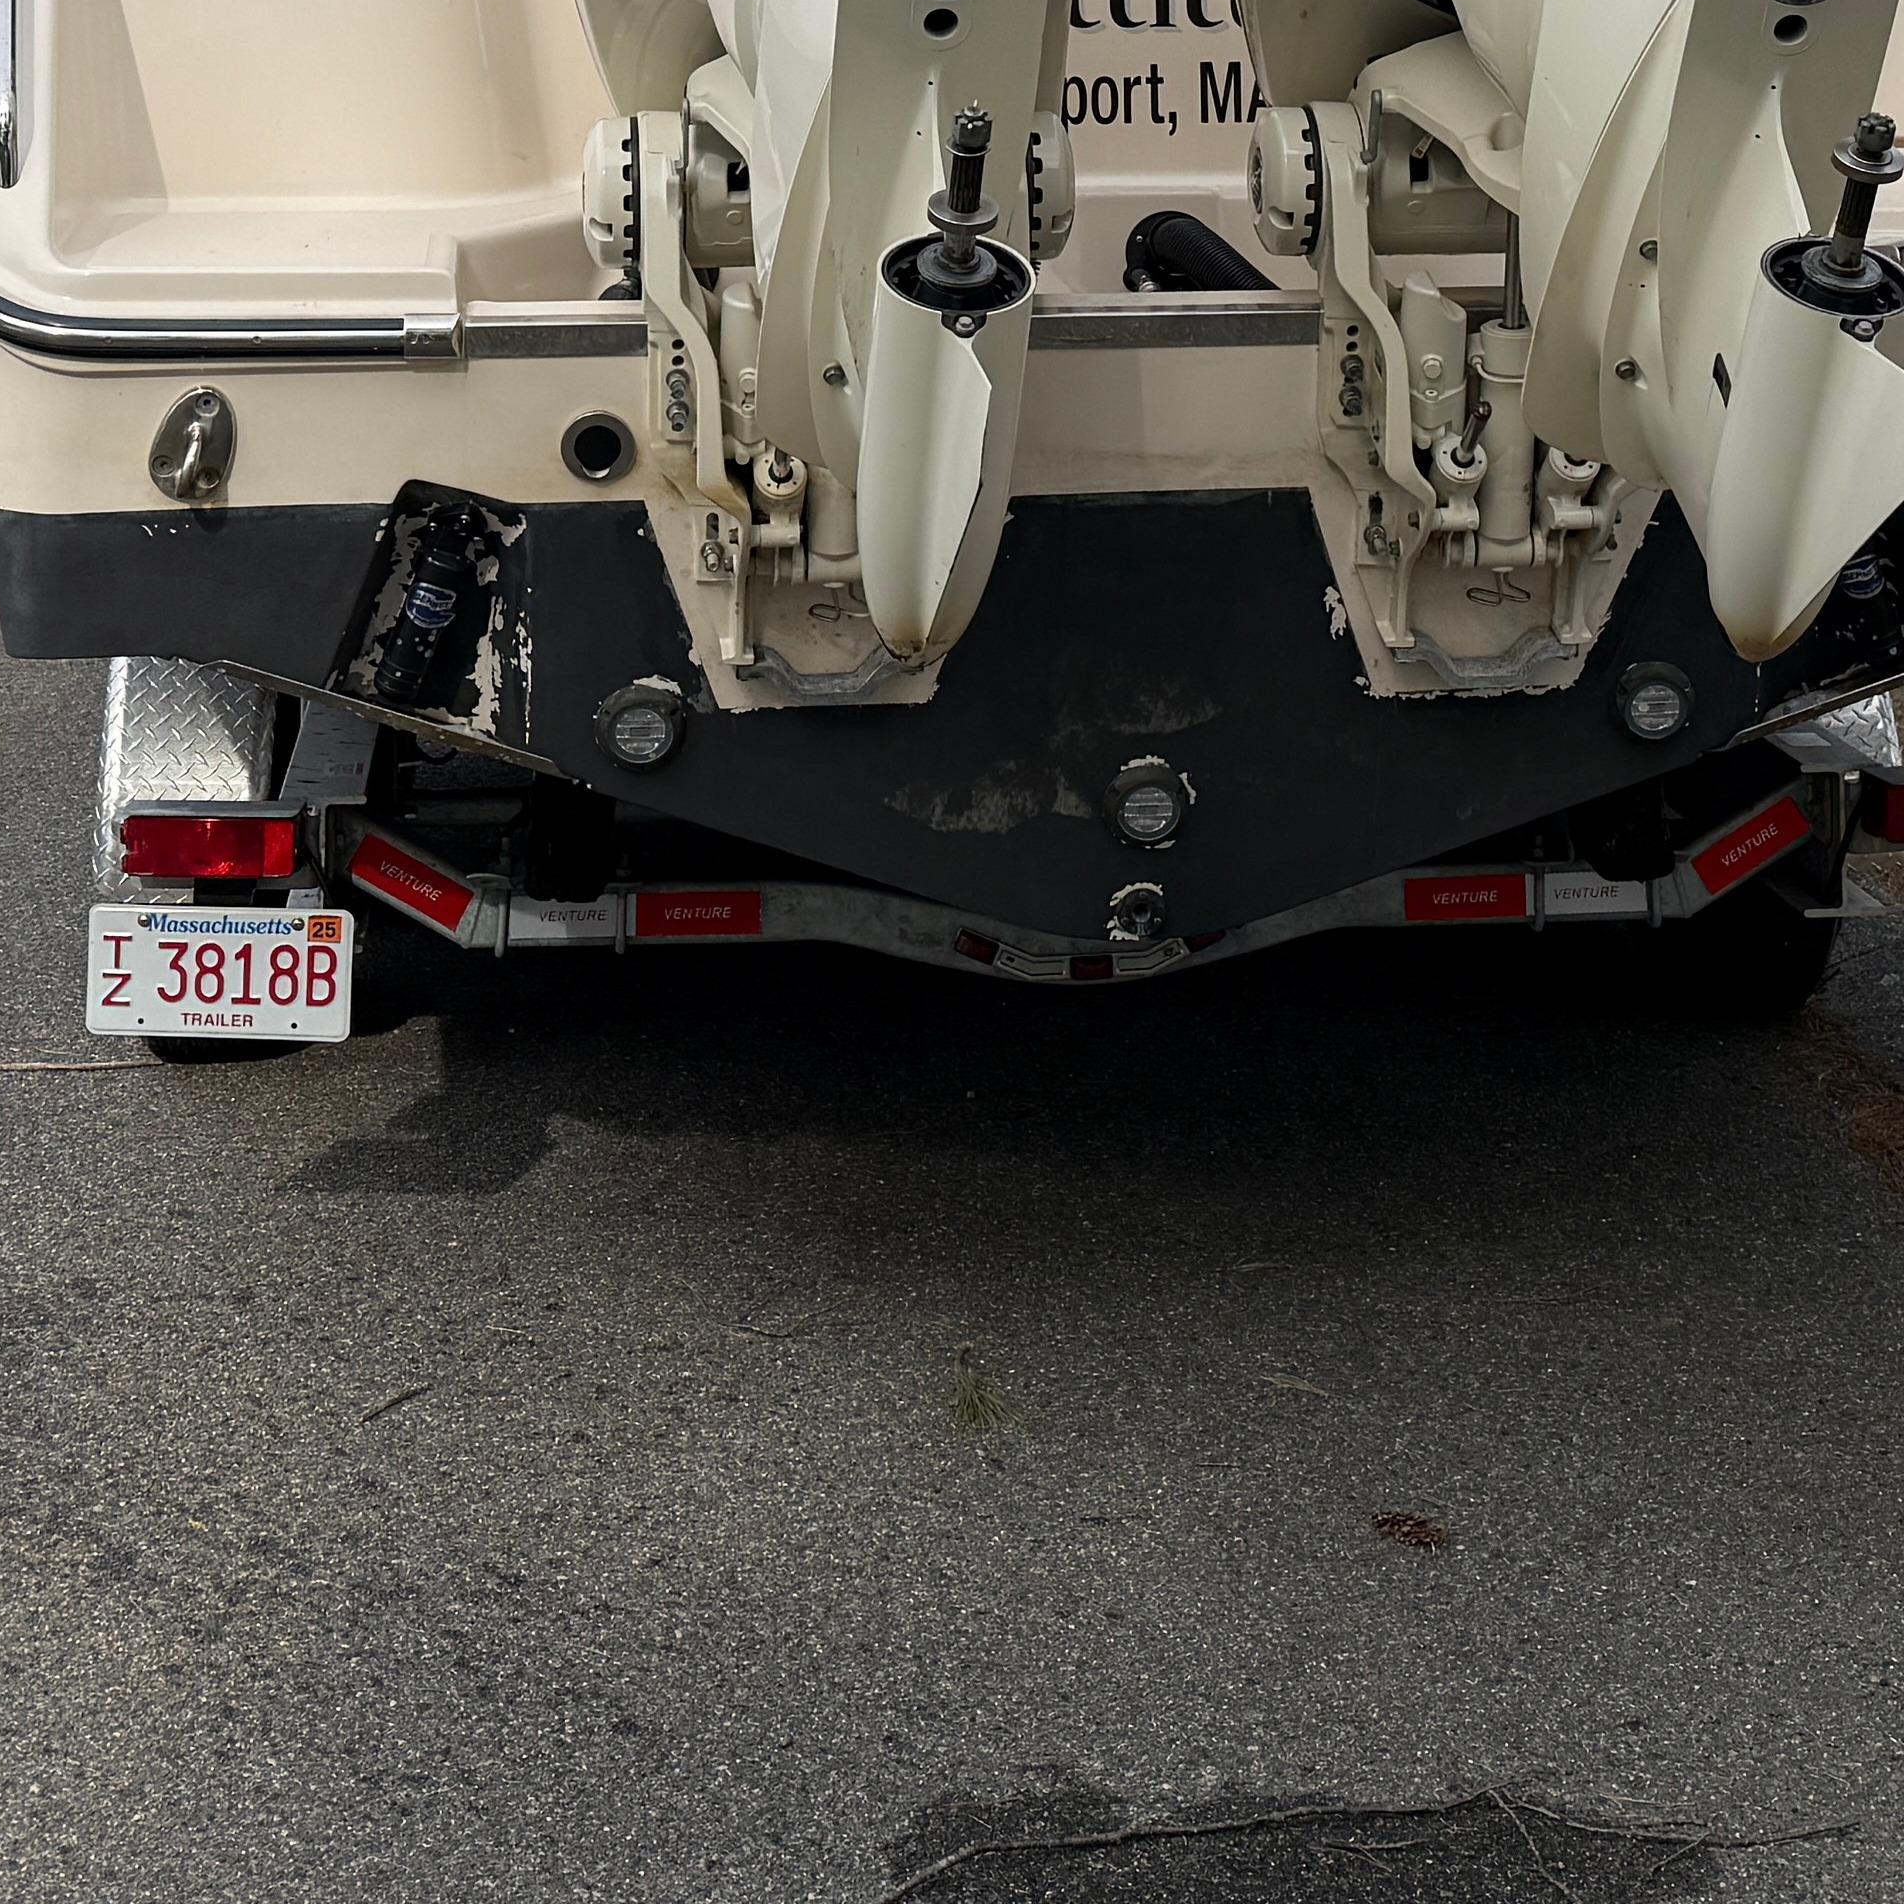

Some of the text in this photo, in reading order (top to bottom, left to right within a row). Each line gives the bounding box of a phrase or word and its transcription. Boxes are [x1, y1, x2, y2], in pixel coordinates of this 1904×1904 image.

[1060, 63, 1178, 137] port,
[1721, 822, 1780, 868] VENTURE
[379, 859, 443, 903] VENTURE
[1432, 889, 1499, 905] VENTURE
[1554, 885, 1620, 900] VENTURE
[539, 907, 609, 923] VENTURE
[664, 905, 733, 921] VENTURE
[147, 911, 294, 936] Massachusetts
[310, 920, 337, 939] 25
[156, 941, 338, 1008] 3818B
[180, 1012, 254, 1028] TRAILER
